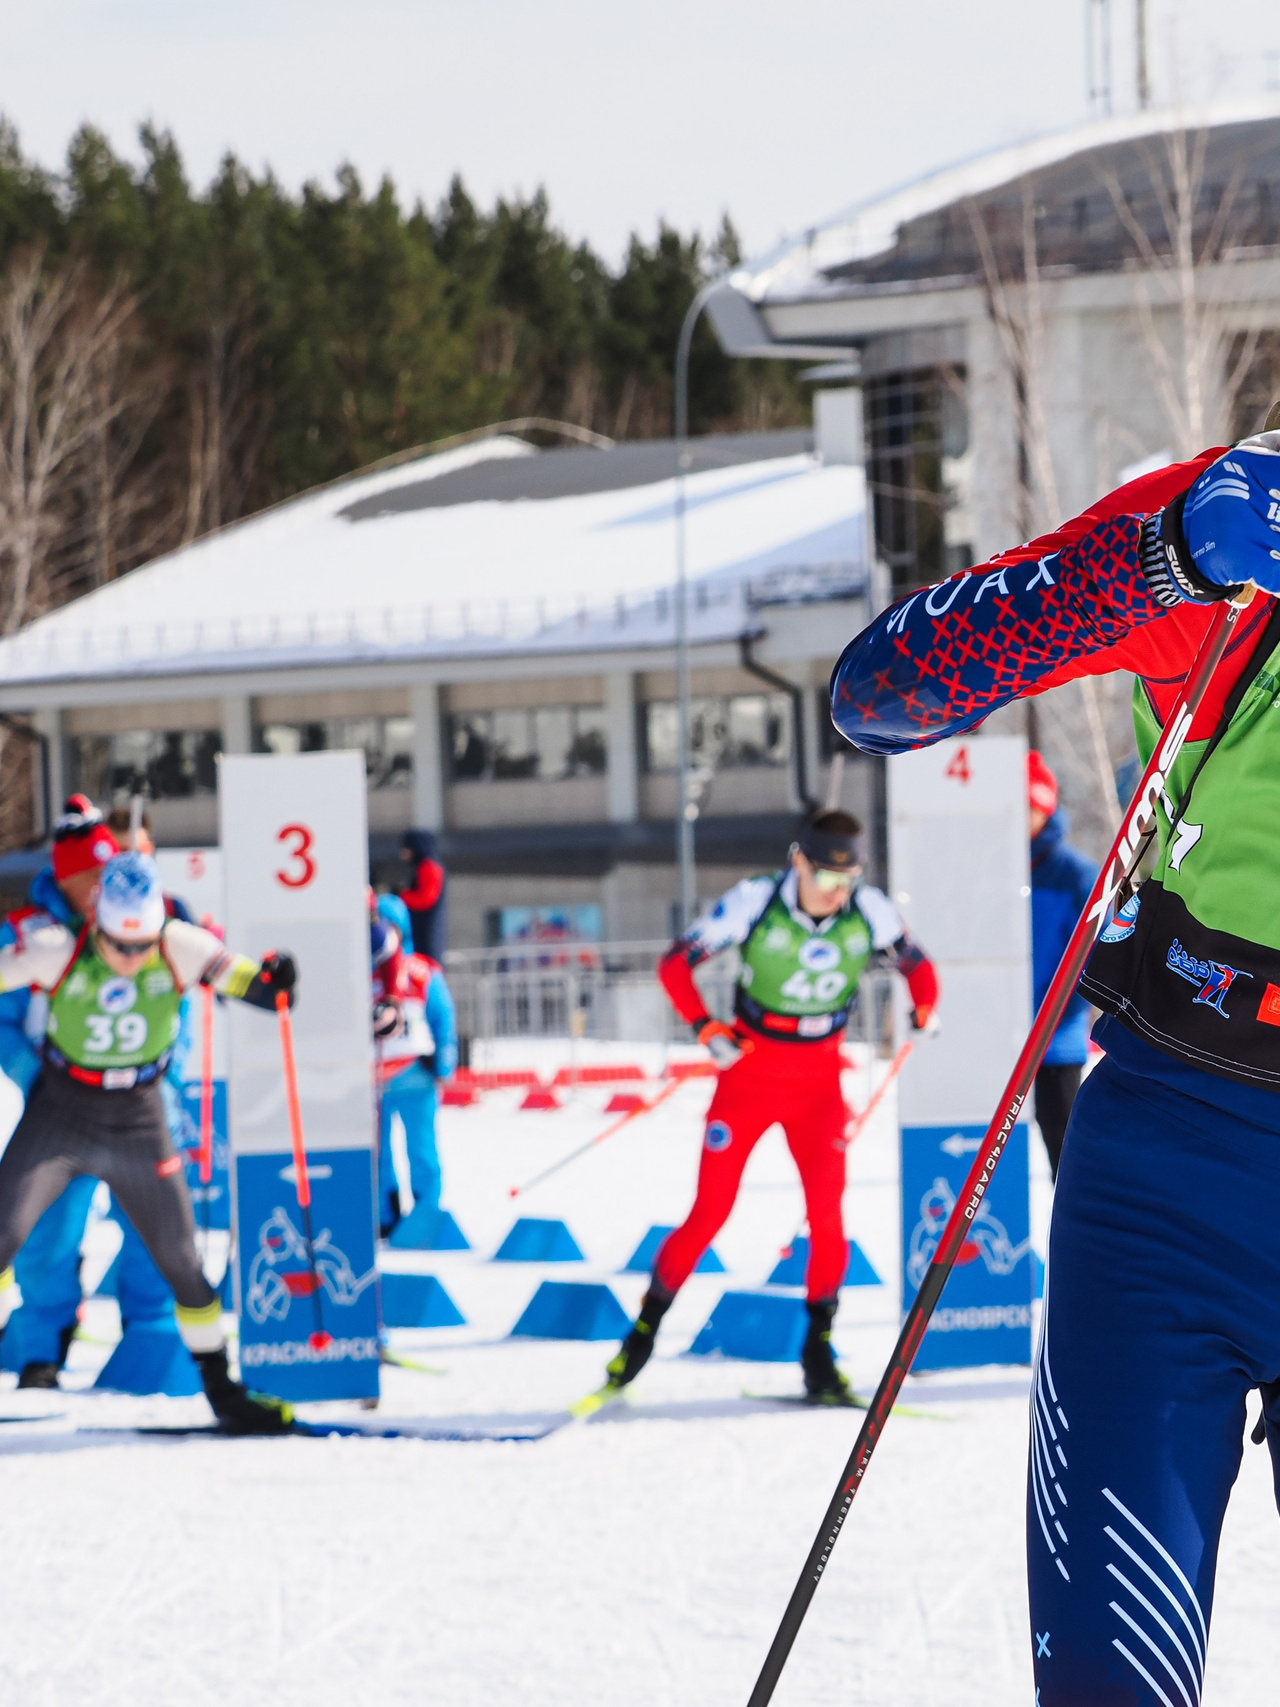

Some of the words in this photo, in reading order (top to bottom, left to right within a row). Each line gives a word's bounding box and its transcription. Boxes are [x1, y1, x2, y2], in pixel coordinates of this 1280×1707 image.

[943, 746, 974, 785] 4
[274, 824, 318, 889] 3
[780, 970, 848, 1002] 40
[82, 1012, 149, 1053] 39
[996, 1093, 1025, 1144] TRIAC
[964, 1169, 989, 1219] AERO
